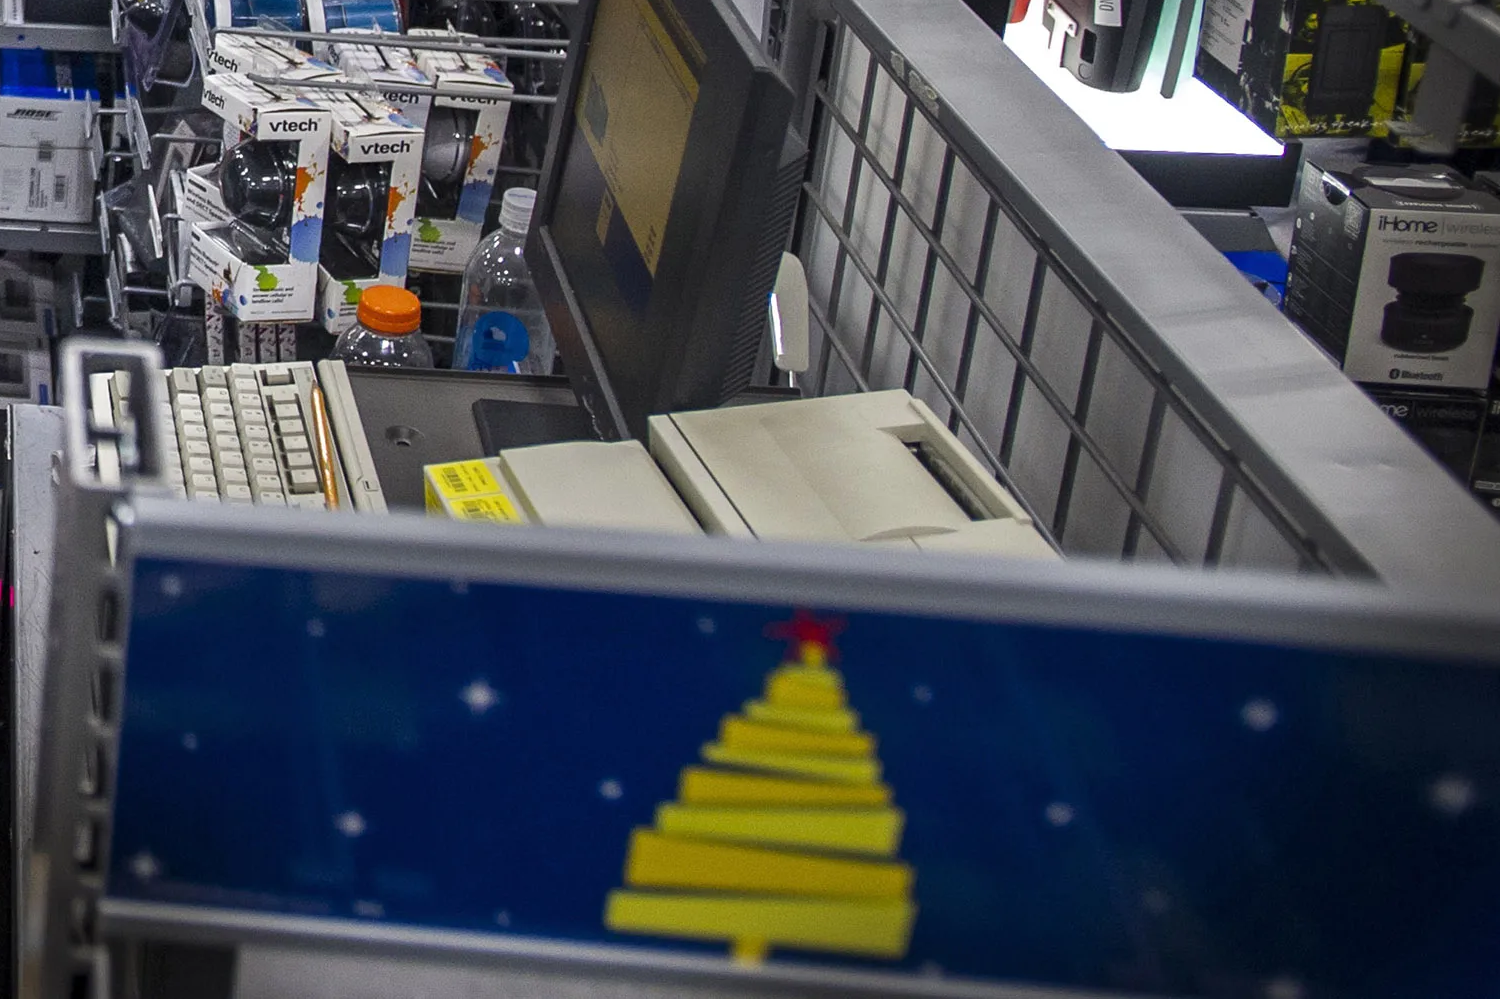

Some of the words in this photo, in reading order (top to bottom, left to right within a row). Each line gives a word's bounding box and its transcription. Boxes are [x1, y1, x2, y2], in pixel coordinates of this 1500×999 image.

[203, 87, 227, 111] vtech
[269, 118, 320, 133] vtech
[360, 139, 411, 155] vtech
[1378, 214, 1439, 234] iHome
